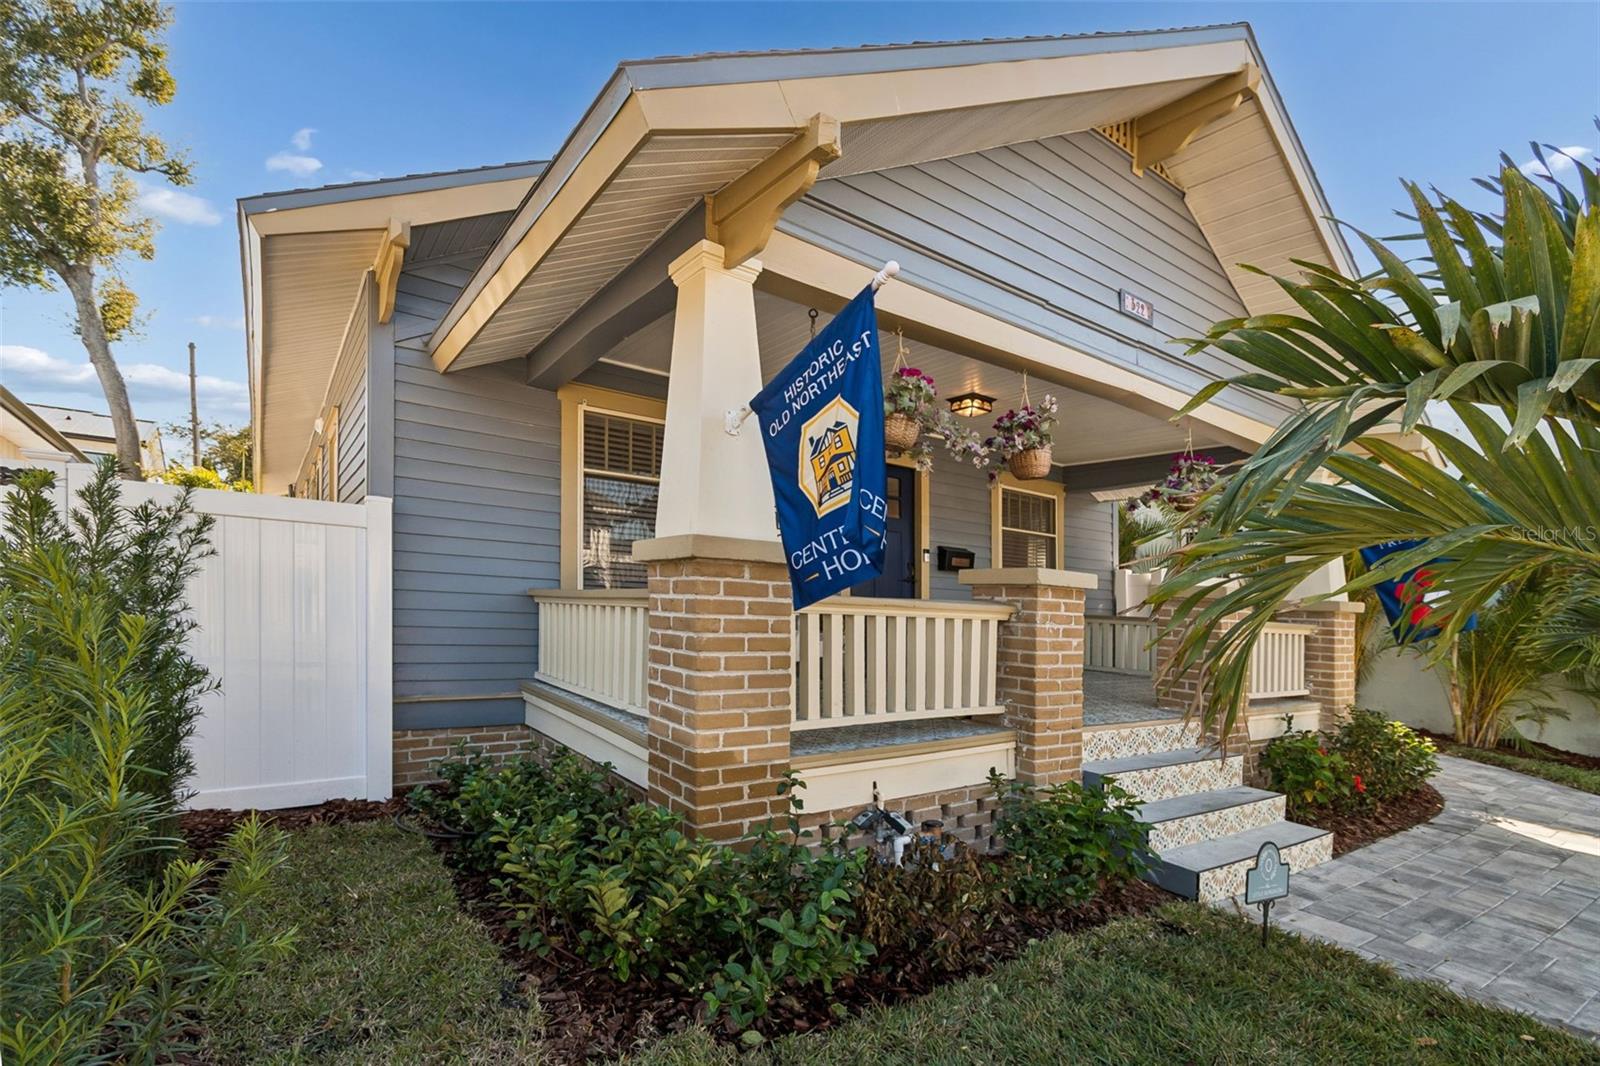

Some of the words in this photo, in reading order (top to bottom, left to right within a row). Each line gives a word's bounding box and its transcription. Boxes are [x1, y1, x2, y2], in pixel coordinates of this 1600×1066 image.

[769, 409, 791, 437] OLD
[791, 330, 871, 415] NORTHEAST
[784, 339, 844, 403] HISTORIC
